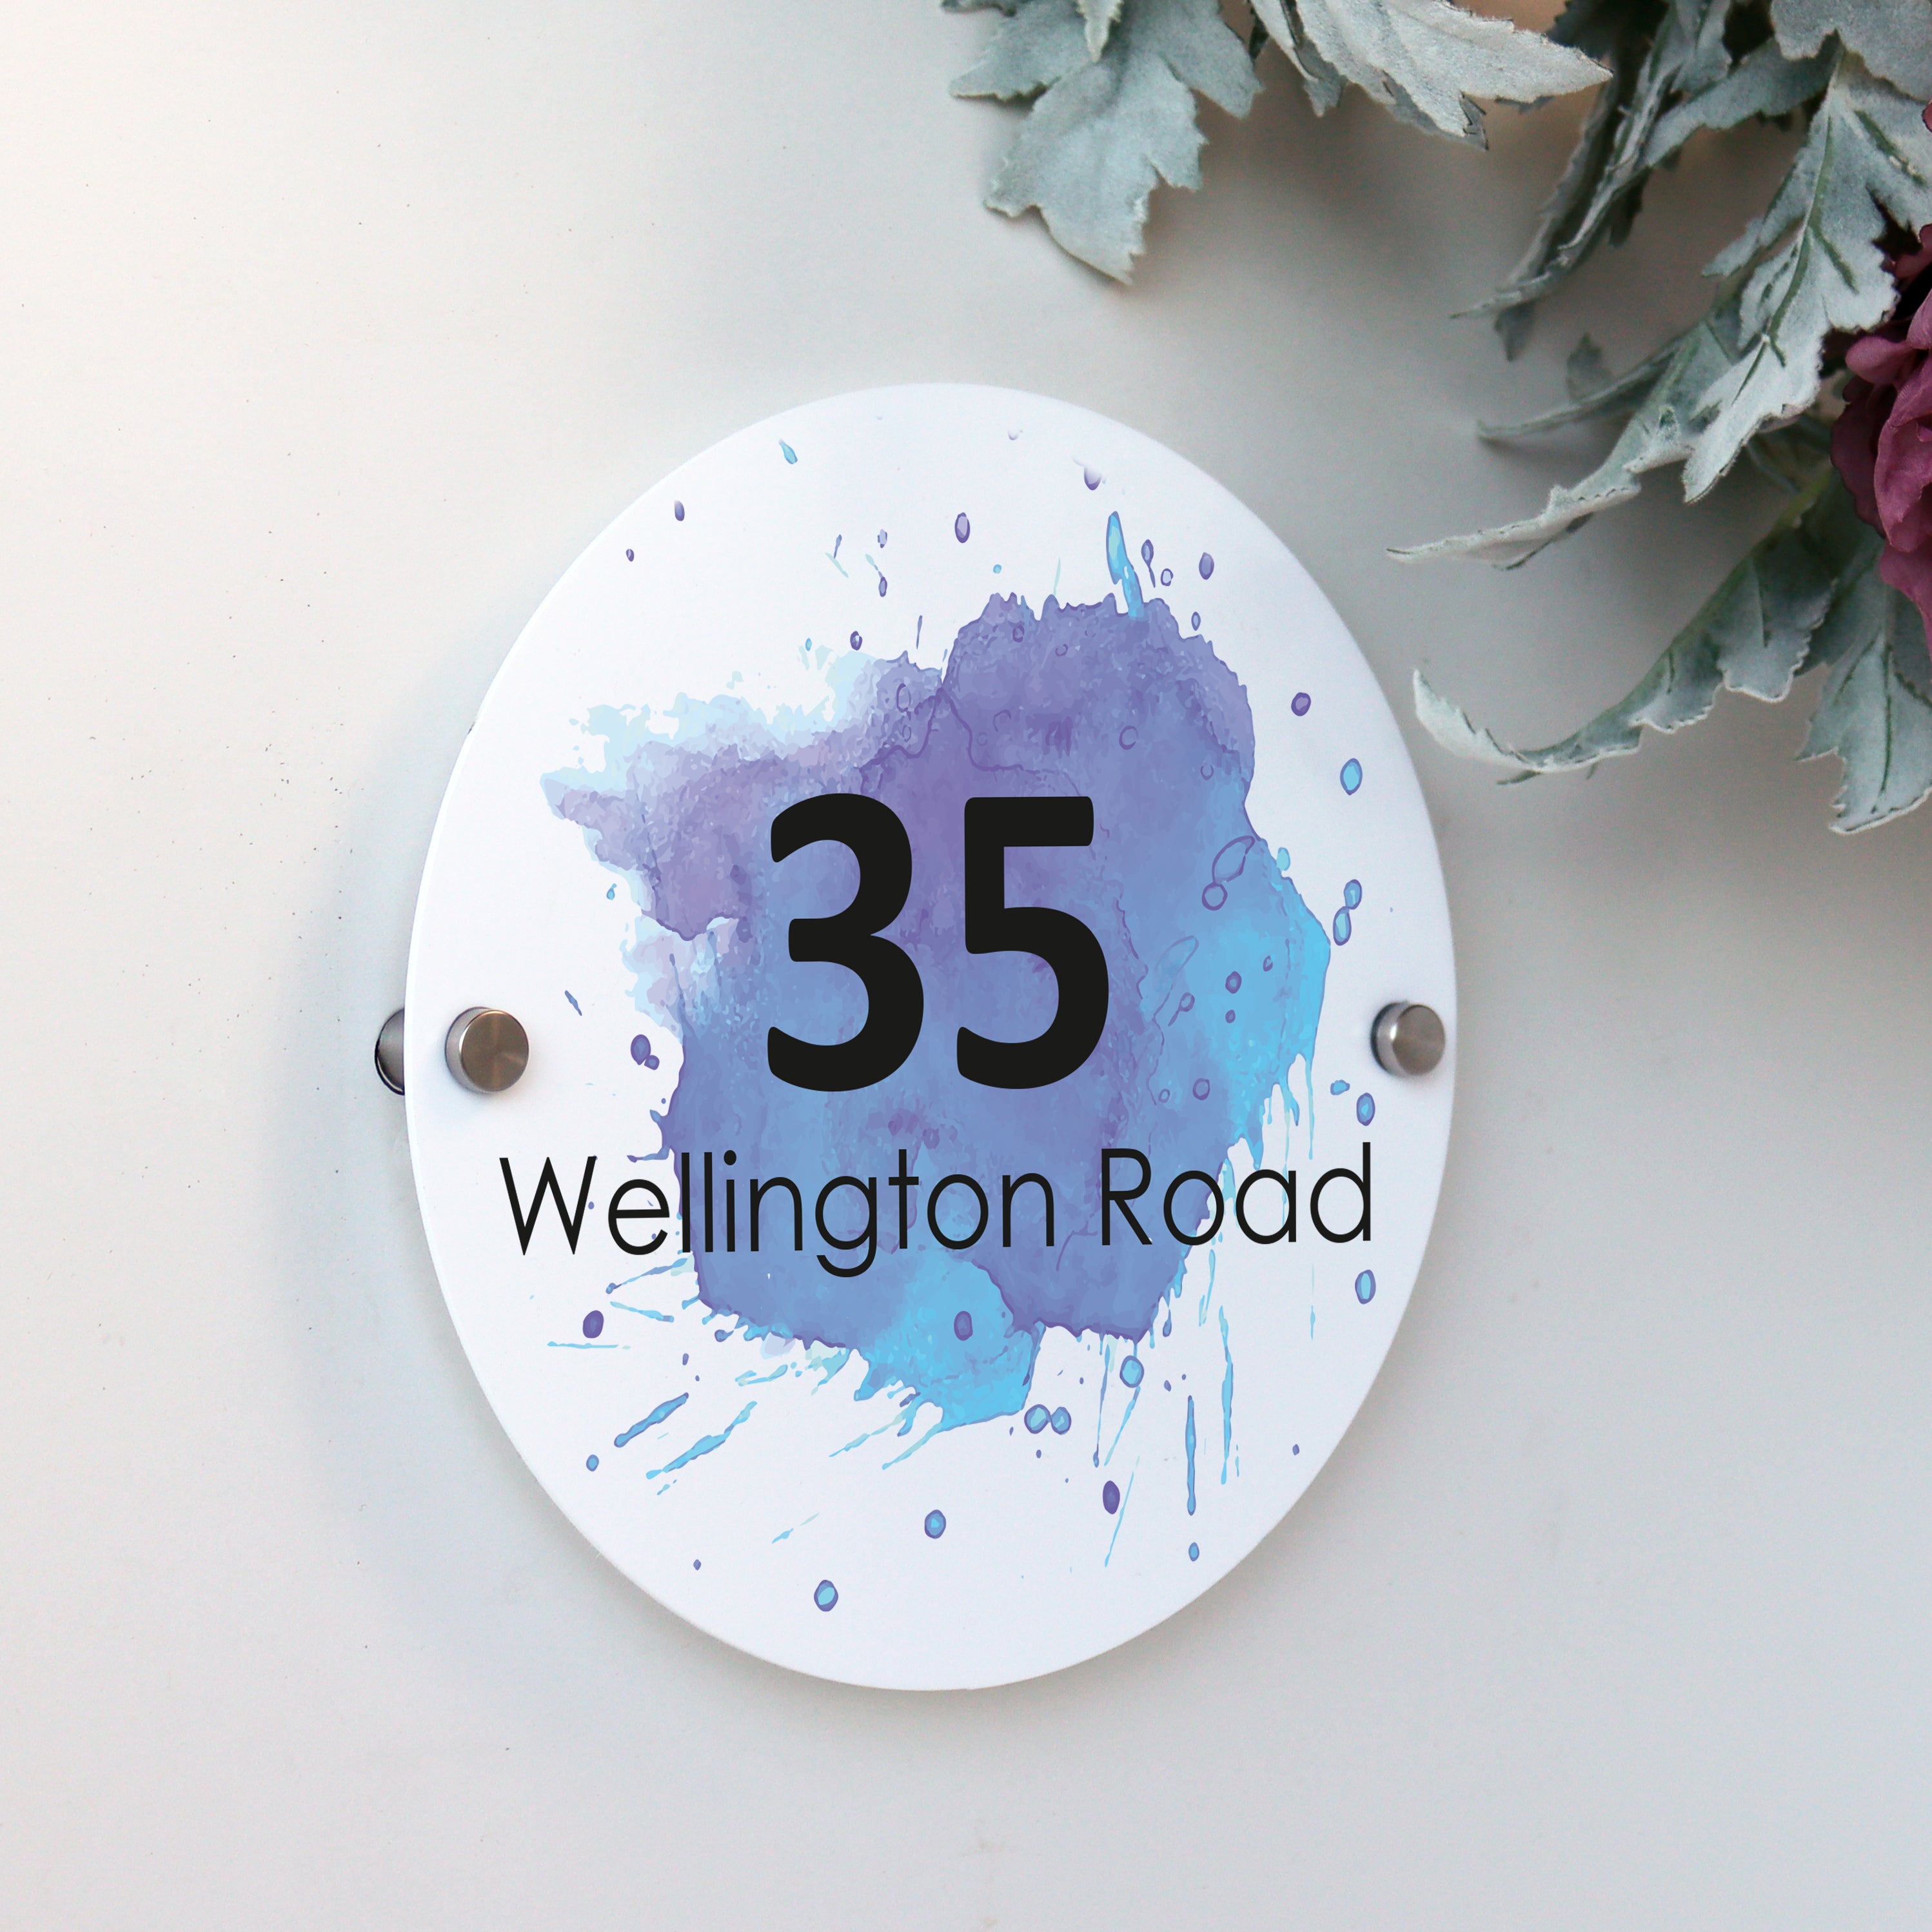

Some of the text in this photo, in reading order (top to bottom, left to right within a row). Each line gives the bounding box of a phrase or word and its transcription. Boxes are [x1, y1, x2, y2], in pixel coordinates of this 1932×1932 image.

[767, 793, 1110, 1092] 35
[498, 1142, 1372, 1277] Wellington Road
